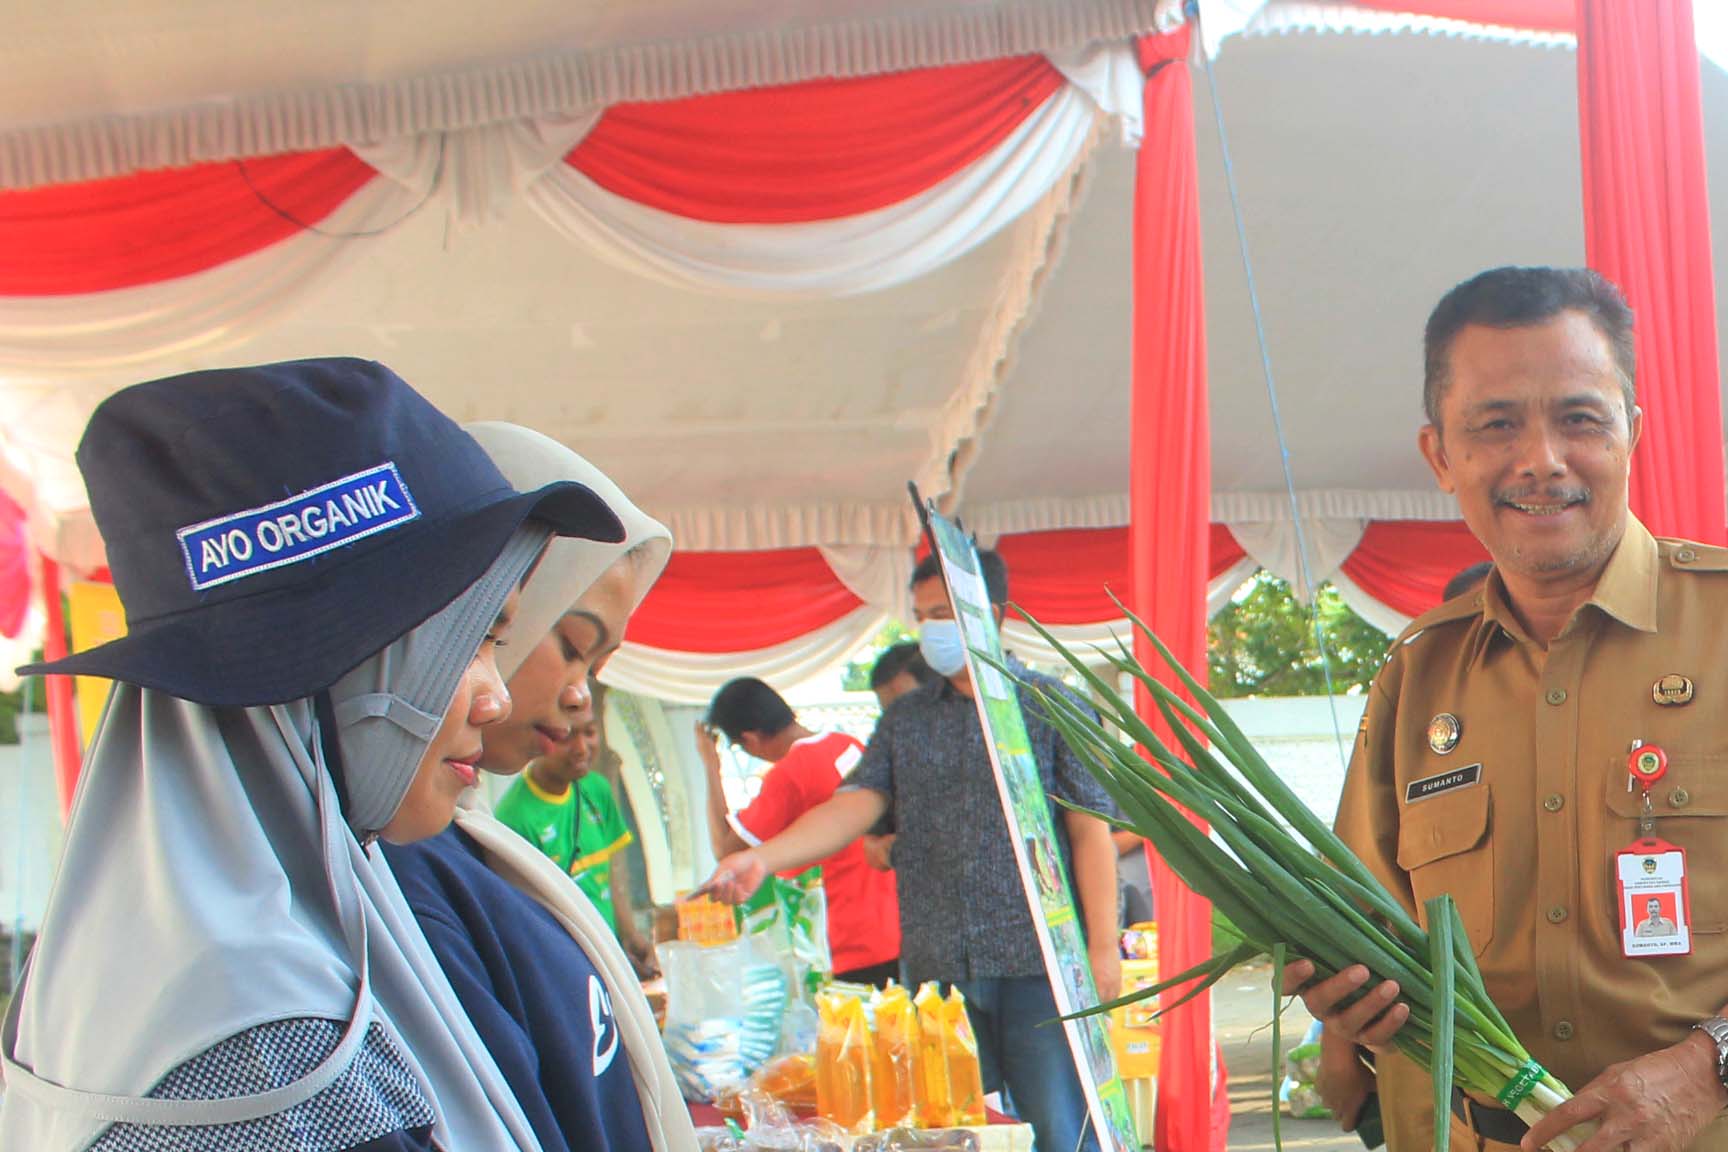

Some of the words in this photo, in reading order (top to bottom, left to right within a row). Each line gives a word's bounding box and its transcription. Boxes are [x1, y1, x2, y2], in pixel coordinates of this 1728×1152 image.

[201, 528, 252, 573] AYO
[256, 480, 401, 552] ORGANIK
[1422, 774, 1463, 792] SUMANTO
